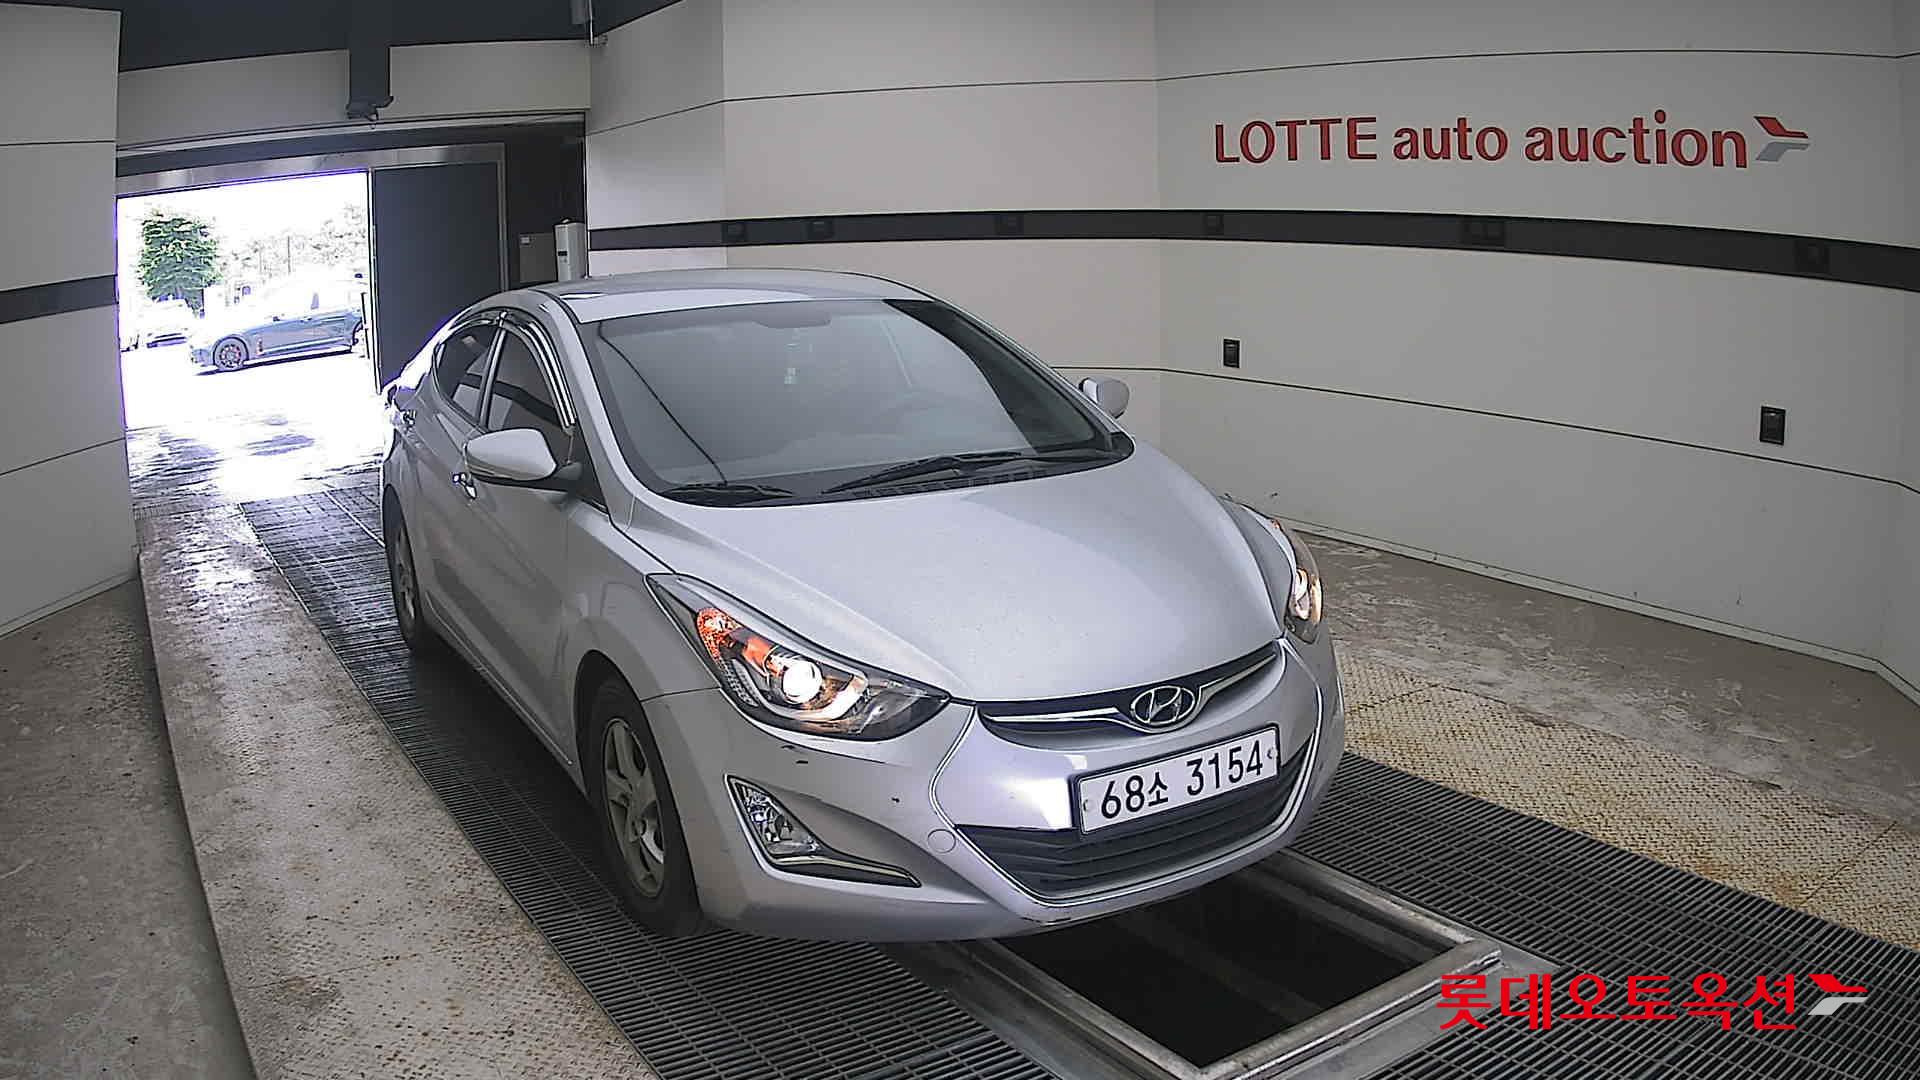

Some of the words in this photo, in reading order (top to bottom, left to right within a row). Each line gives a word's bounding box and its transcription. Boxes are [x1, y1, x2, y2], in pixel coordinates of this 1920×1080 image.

[1215, 117, 1377, 163] LOTTE
[1392, 116, 1508, 163] auto
[1523, 109, 1748, 169] auction
[1100, 771, 1169, 819] 68소
[1186, 739, 1264, 796] 3154
